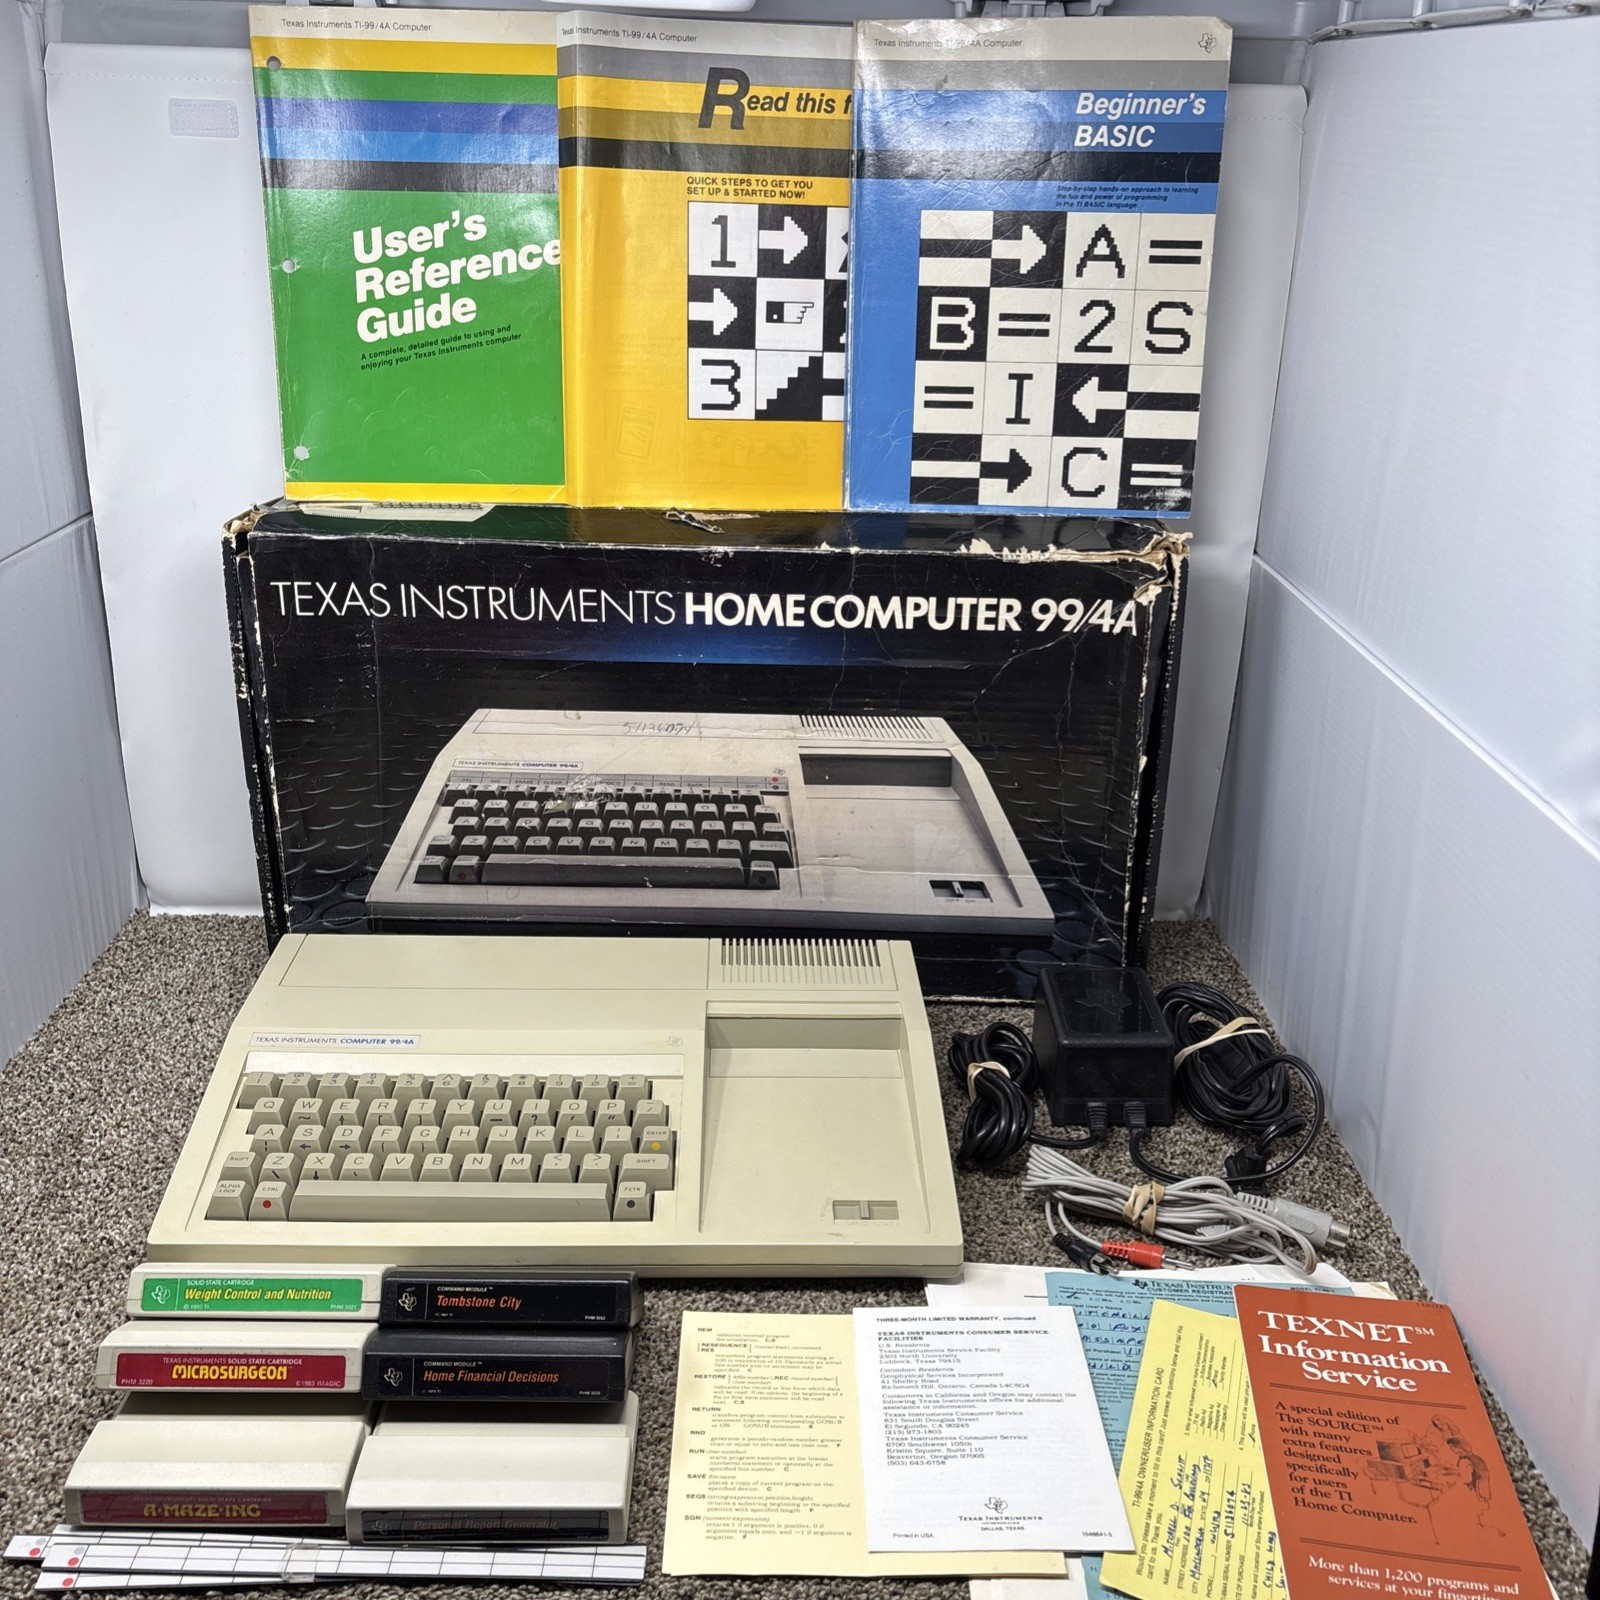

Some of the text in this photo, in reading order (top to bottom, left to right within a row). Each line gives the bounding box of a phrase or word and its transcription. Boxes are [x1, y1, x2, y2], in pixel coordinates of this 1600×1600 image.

[281, 18, 304, 28] Texas
[306, 20, 352, 29] Instruments
[392, 22, 431, 33] Computer
[575, 26, 620, 38] Instruments
[659, 32, 698, 43] Computer
[874, 39, 896, 48] Texas
[983, 39, 1023, 50] Computer
[698, 66, 836, 131] Read this
[1075, 92, 1207, 121] Beginner's
[1074, 125, 1156, 148] BASIC
[687, 176, 813, 190] QUICK STEPS TO GET YOU
[687, 186, 806, 199] SET UP & STARTED NOW!
[352, 210, 487, 264] User's
[711, 215, 736, 268] 1
[1076, 224, 1126, 279] A
[355, 239, 561, 303] Reference
[357, 292, 477, 343] Guide
[929, 296, 1193, 354] B 2 S
[361, 353, 366, 361] A
[408, 339, 439, 352] detailed
[441, 334, 462, 347] guide
[464, 332, 472, 340] to
[474, 329, 495, 343] using
[497, 324, 511, 334] and
[361, 333, 522, 371] enjoying your Texas Instruments computer
[701, 359, 741, 411] 3
[1061, 447, 1108, 498] C
[269, 581, 1138, 637] TEXAS INSTRUMENTS HOME COMPUTER 99/4A
[255, 1036, 279, 1044] TEXAS
[281, 1037, 337, 1045] INSTRUMENTS
[340, 1038, 386, 1046] COMPUTER
[184, 1288, 332, 1302] Weight Control and Nutrition
[1147, 1287, 1190, 1295] CUSTOMER
[1150, 1281, 1184, 1289] TEXAS
[437, 1295, 522, 1310] Tombstone City
[1258, 1334, 1452, 1374] Information
[171, 1364, 288, 1380] MICROSURGEON
[423, 1371, 559, 1383] Home Financial Decisions
[1302, 1361, 1418, 1392] Service
[1146, 1386, 1161, 1431] INFORMATION
[1155, 1367, 1164, 1385] CARD
[1275, 1401, 1400, 1426] A special edition of
[1276, 1412, 1304, 1425] The
[1279, 1424, 1351, 1444] with many
[1282, 1437, 1372, 1457] extra features
[1284, 1447, 1342, 1465] designed
[1286, 1461, 1359, 1481] specifically
[1288, 1471, 1348, 1489] for users
[1291, 1484, 1354, 1502] of the TI
[1293, 1496, 1418, 1524] Home Computer.
[413, 1519, 558, 1532] Personal Report Generator
[1309, 1556, 1519, 1595] More than 1,200 programs and
[1328, 1572, 1434, 1598] services at your
